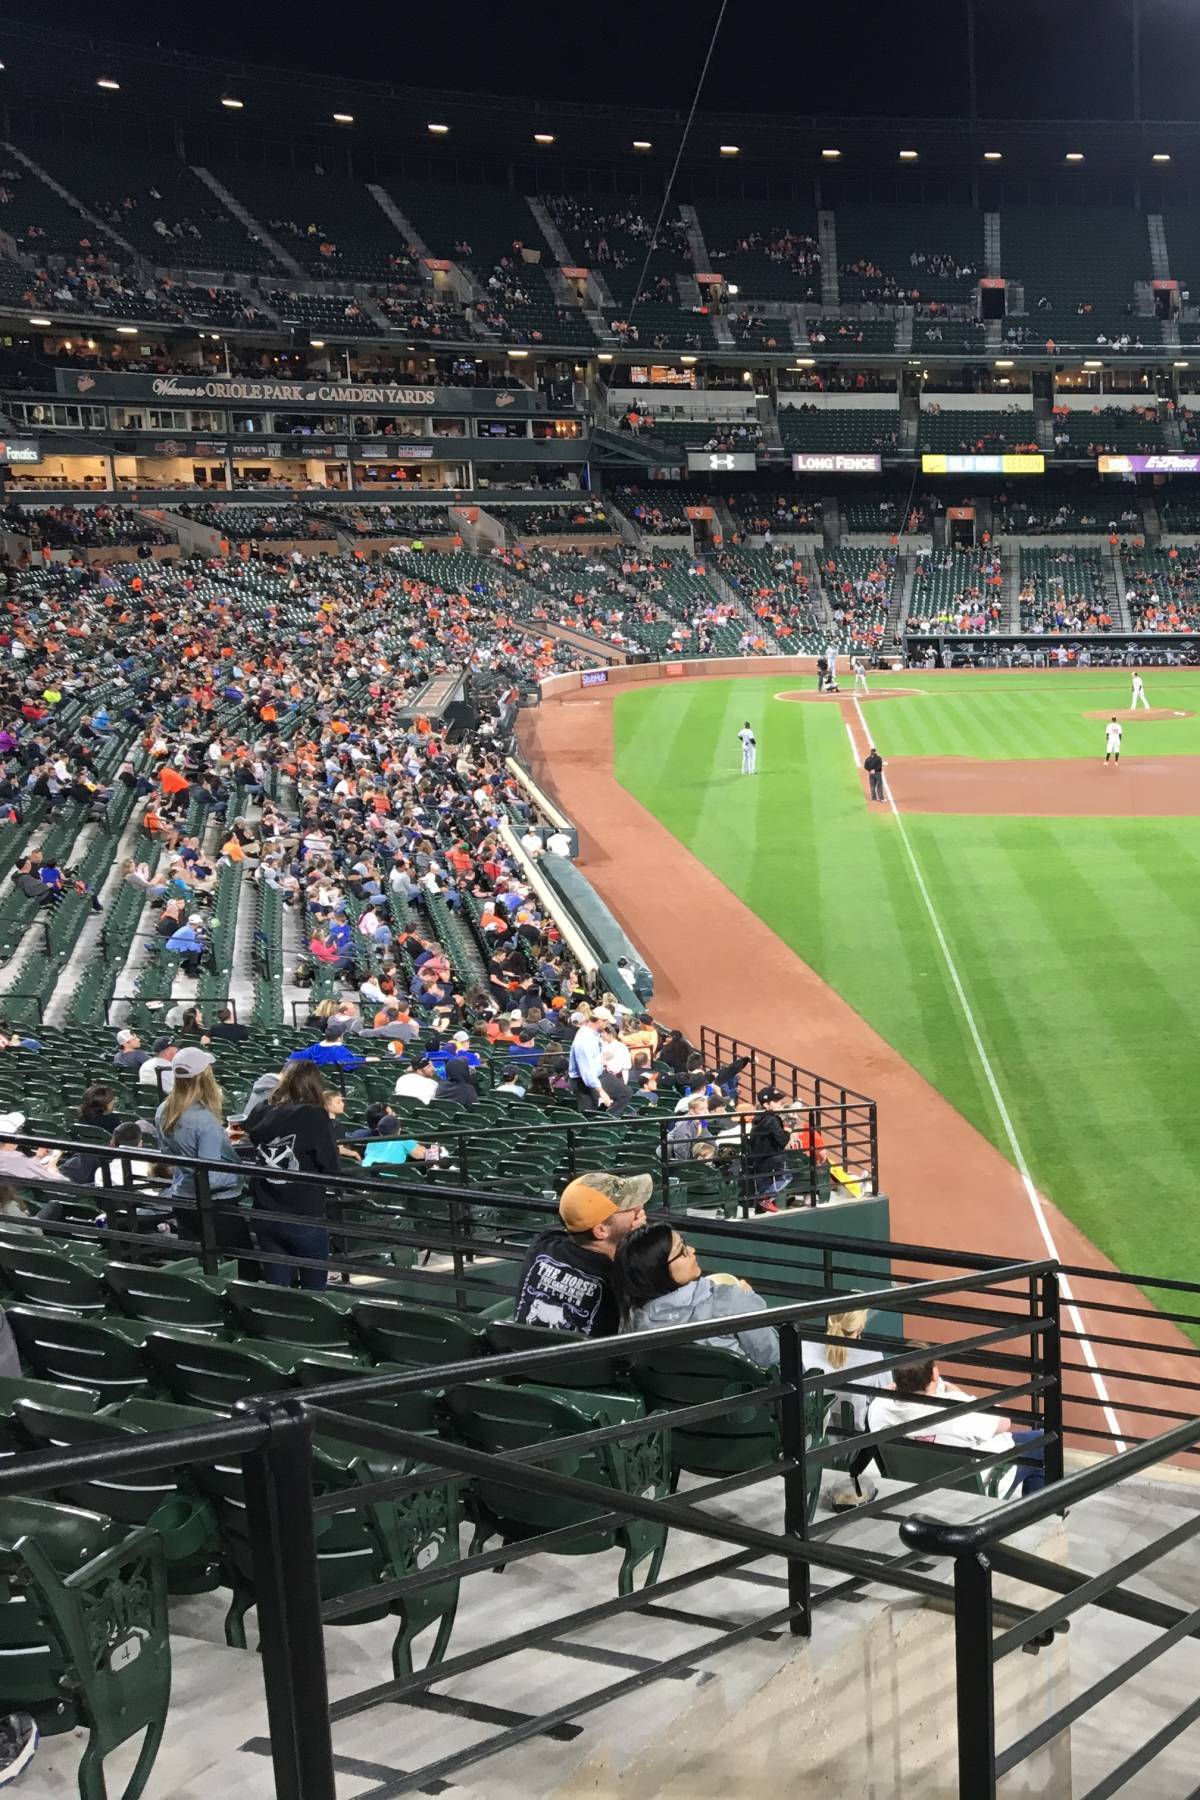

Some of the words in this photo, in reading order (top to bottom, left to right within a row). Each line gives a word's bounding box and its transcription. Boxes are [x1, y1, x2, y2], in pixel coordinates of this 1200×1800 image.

[152, 378, 195, 396] Welcome
[205, 382, 260, 399] ORIOLE
[263, 384, 304, 400] PARK
[318, 386, 384, 402] CAMDEN
[385, 389, 435, 404] YARDS
[6, 446, 38, 460] Fanatics
[798, 455, 833, 469] LONG
[836, 455, 876, 470] FENCE
[1006, 457, 1041, 471] SEASON
[537, 1262, 561, 1280] THE
[561, 1273, 597, 1297] HORSE
[121, 1645, 131, 1660] 4
